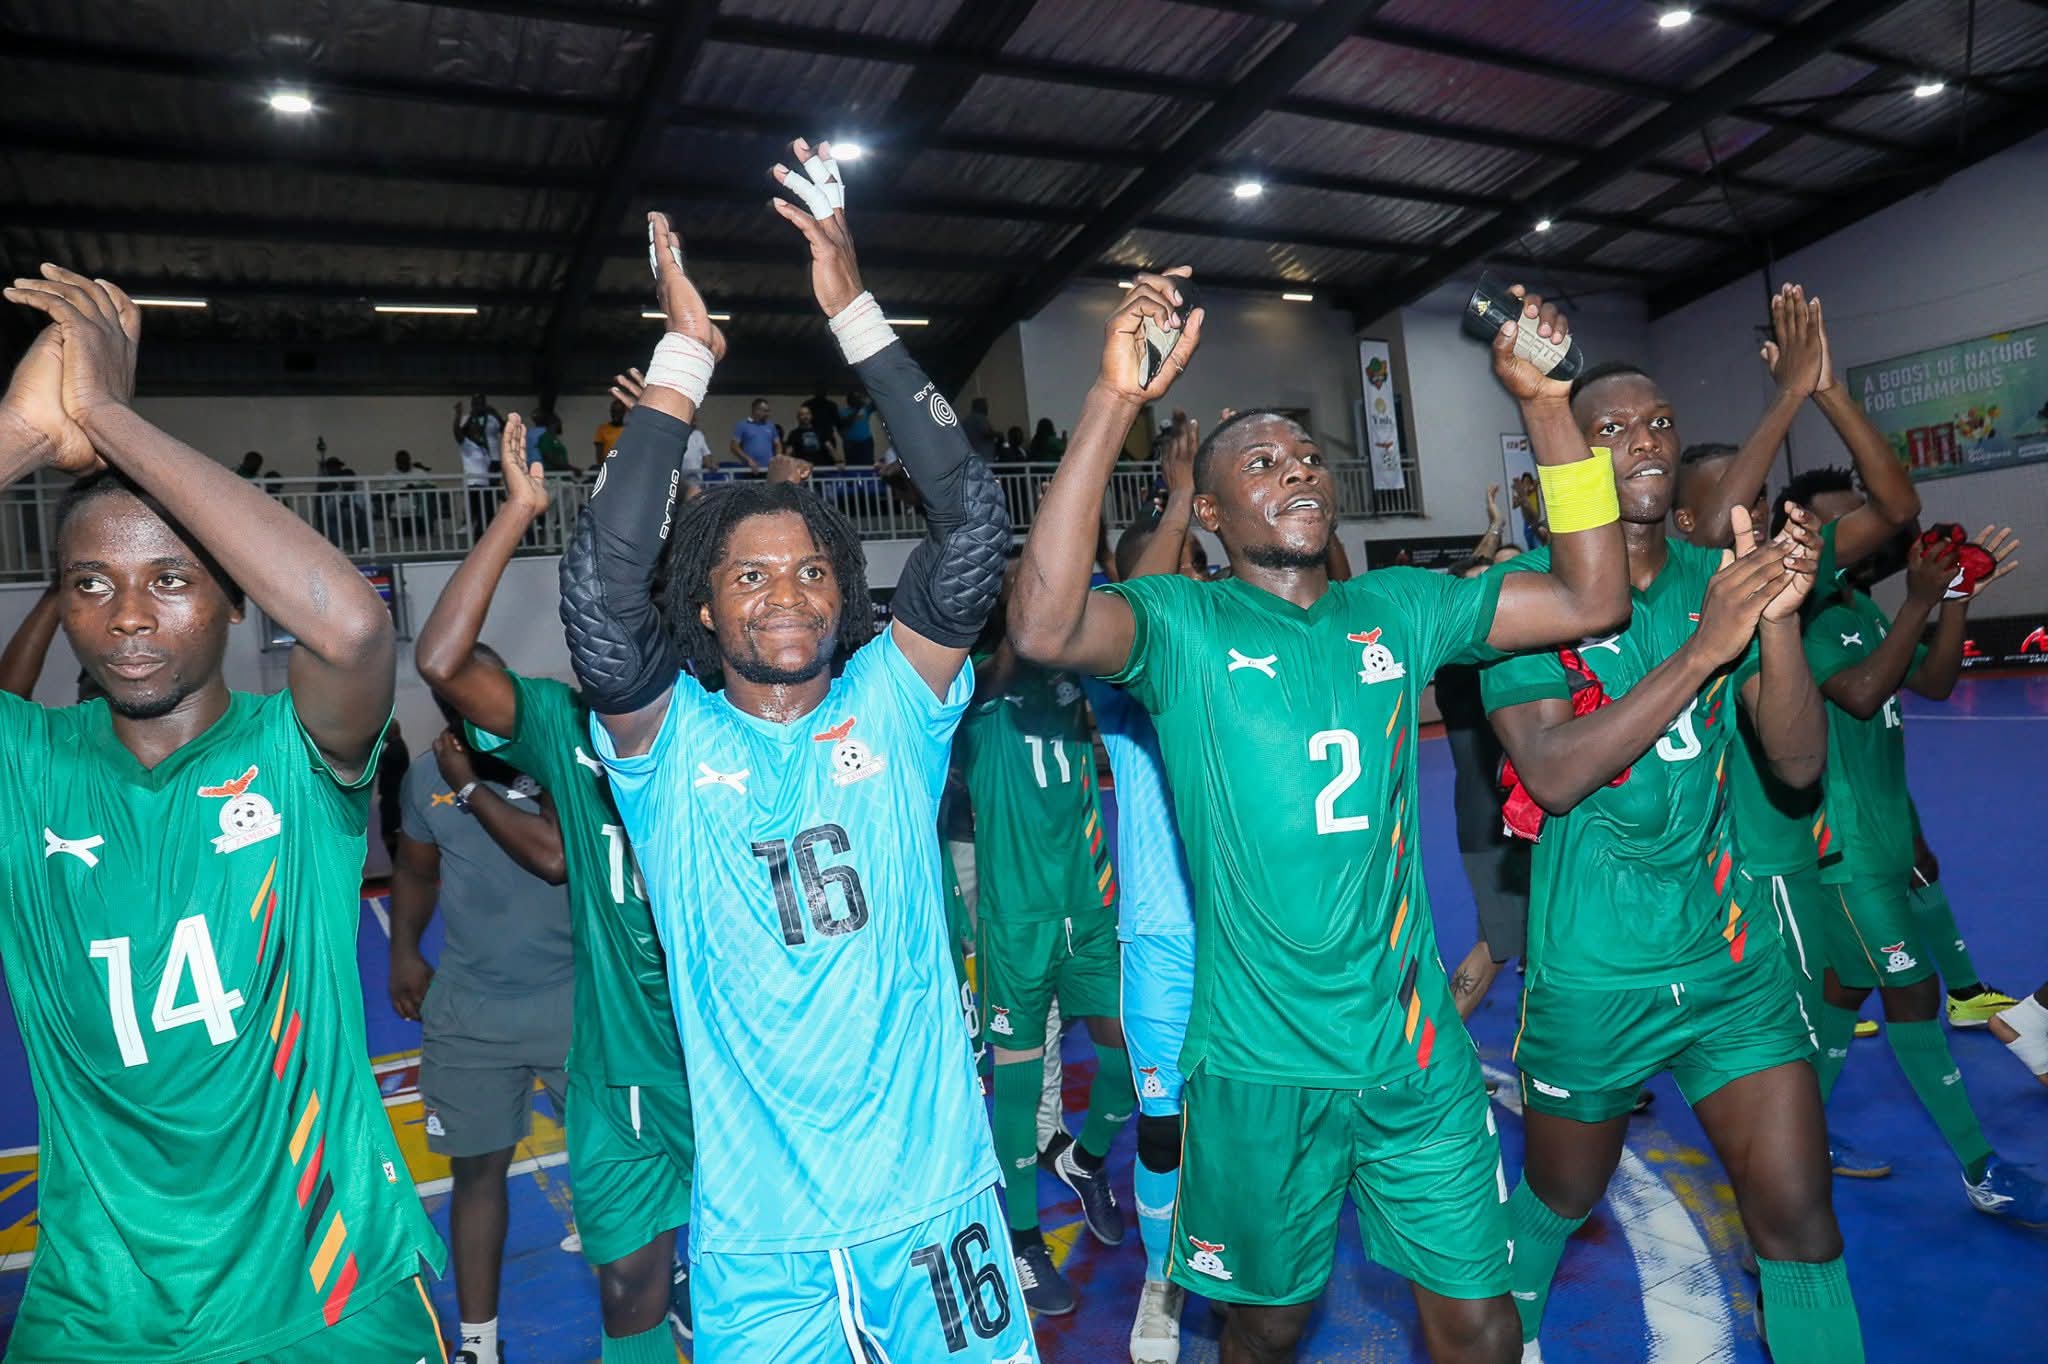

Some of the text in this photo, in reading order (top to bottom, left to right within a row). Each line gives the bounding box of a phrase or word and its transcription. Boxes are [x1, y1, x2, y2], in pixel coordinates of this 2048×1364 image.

[1864, 337, 2038, 394] A BOOST OF NATURE
[1865, 367, 2002, 414] FOR CHAMPIONS
[1024, 735, 1071, 788] 11
[1308, 728, 1370, 835] 2
[750, 823, 869, 946] 16
[89, 913, 246, 1068] 14
[911, 1222, 1011, 1354] 16
